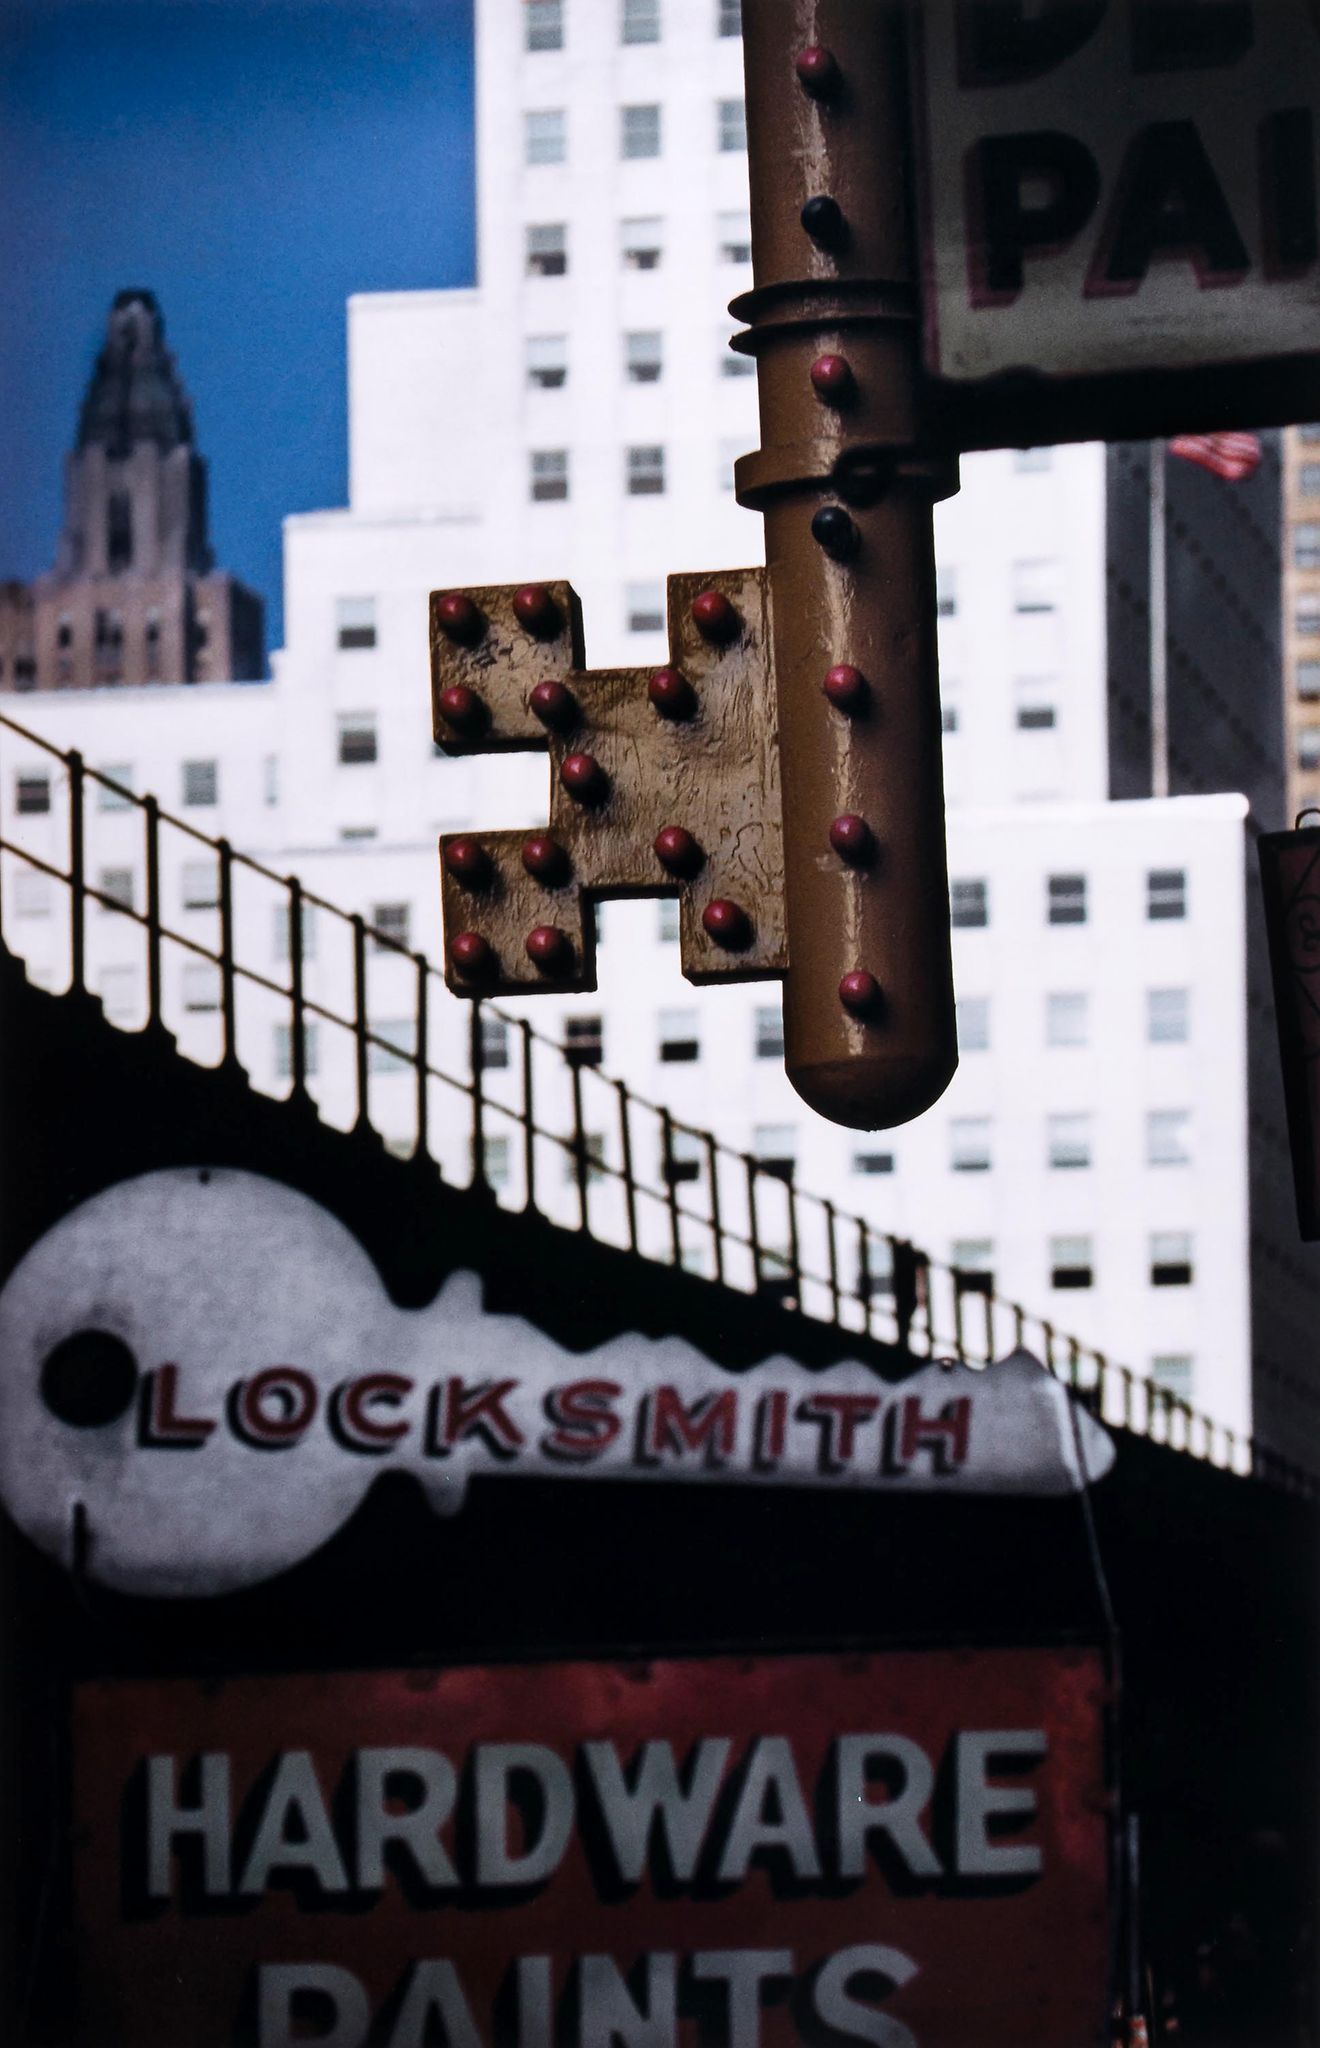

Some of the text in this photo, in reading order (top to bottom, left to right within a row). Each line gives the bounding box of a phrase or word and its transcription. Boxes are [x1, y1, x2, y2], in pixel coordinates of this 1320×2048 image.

[138, 1362, 973, 1474] LOCKSMITH
[145, 1729, 1047, 1897] HARDWARE
[257, 1944, 920, 2048] PAINTS
